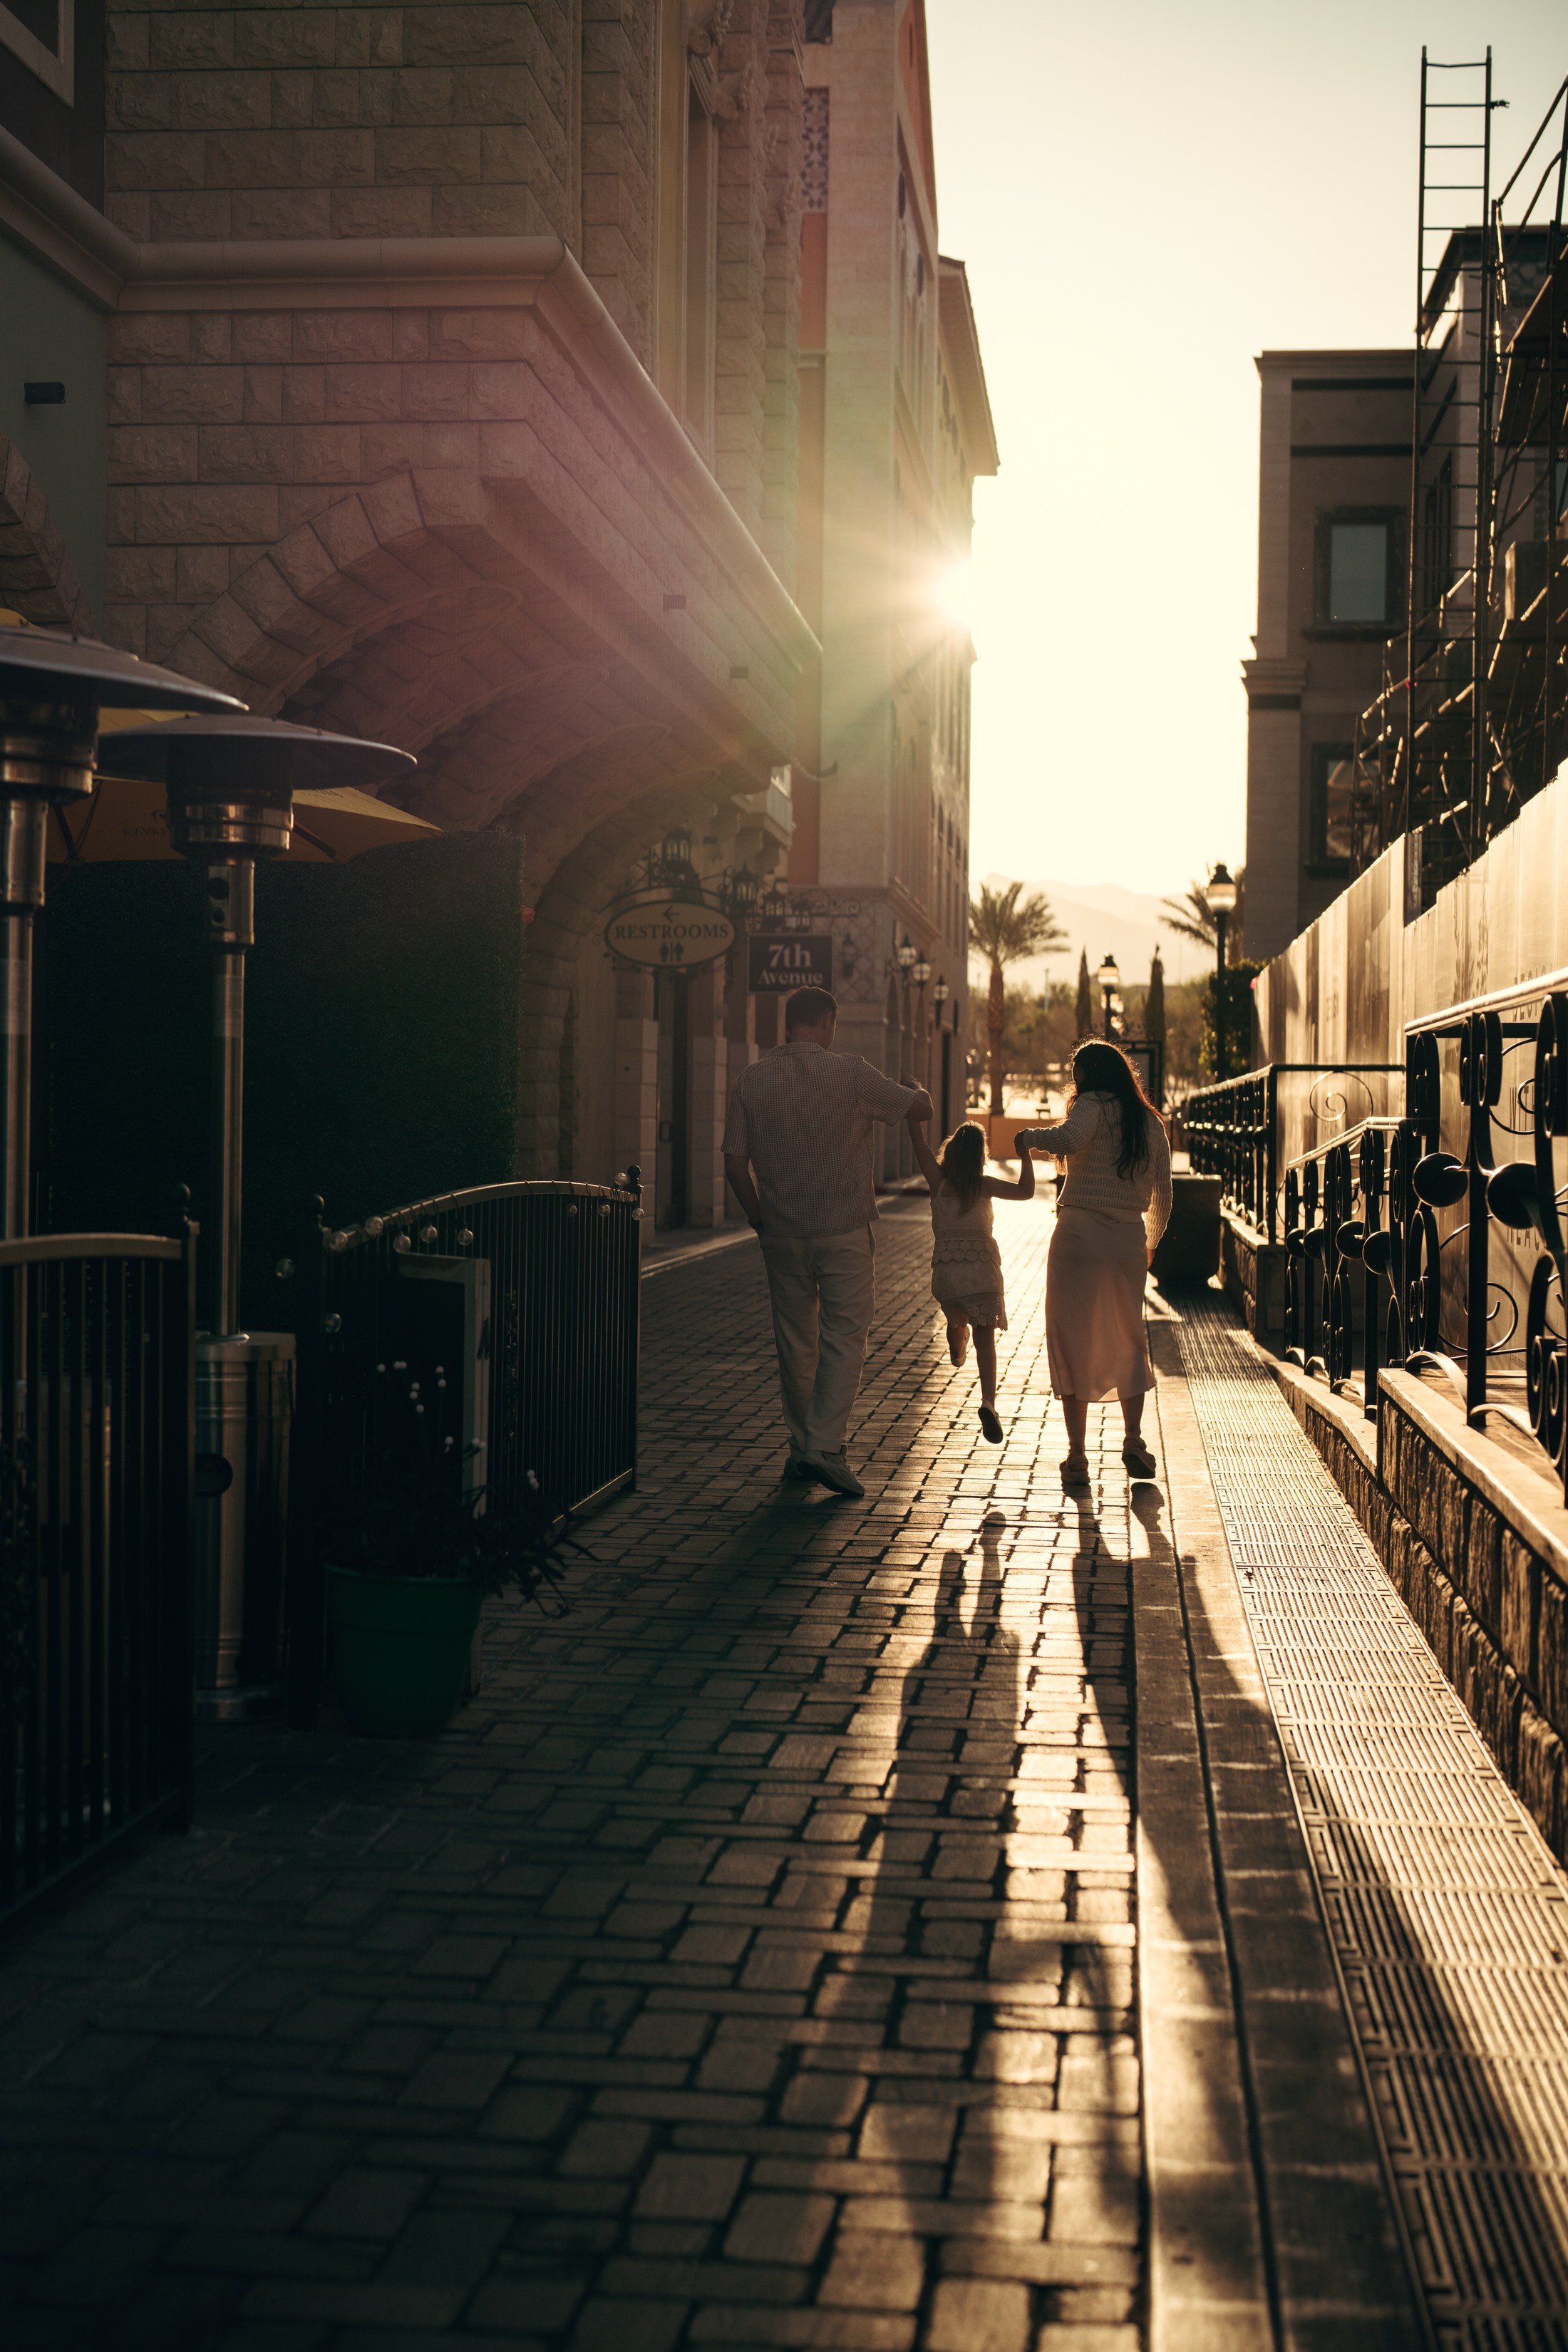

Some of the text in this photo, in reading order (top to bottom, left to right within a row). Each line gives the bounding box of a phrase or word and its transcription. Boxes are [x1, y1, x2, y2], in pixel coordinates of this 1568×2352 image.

[616, 924, 728, 939] RESTROOMS
[769, 943, 811, 968] 7th
[758, 969, 823, 986] Avenue
